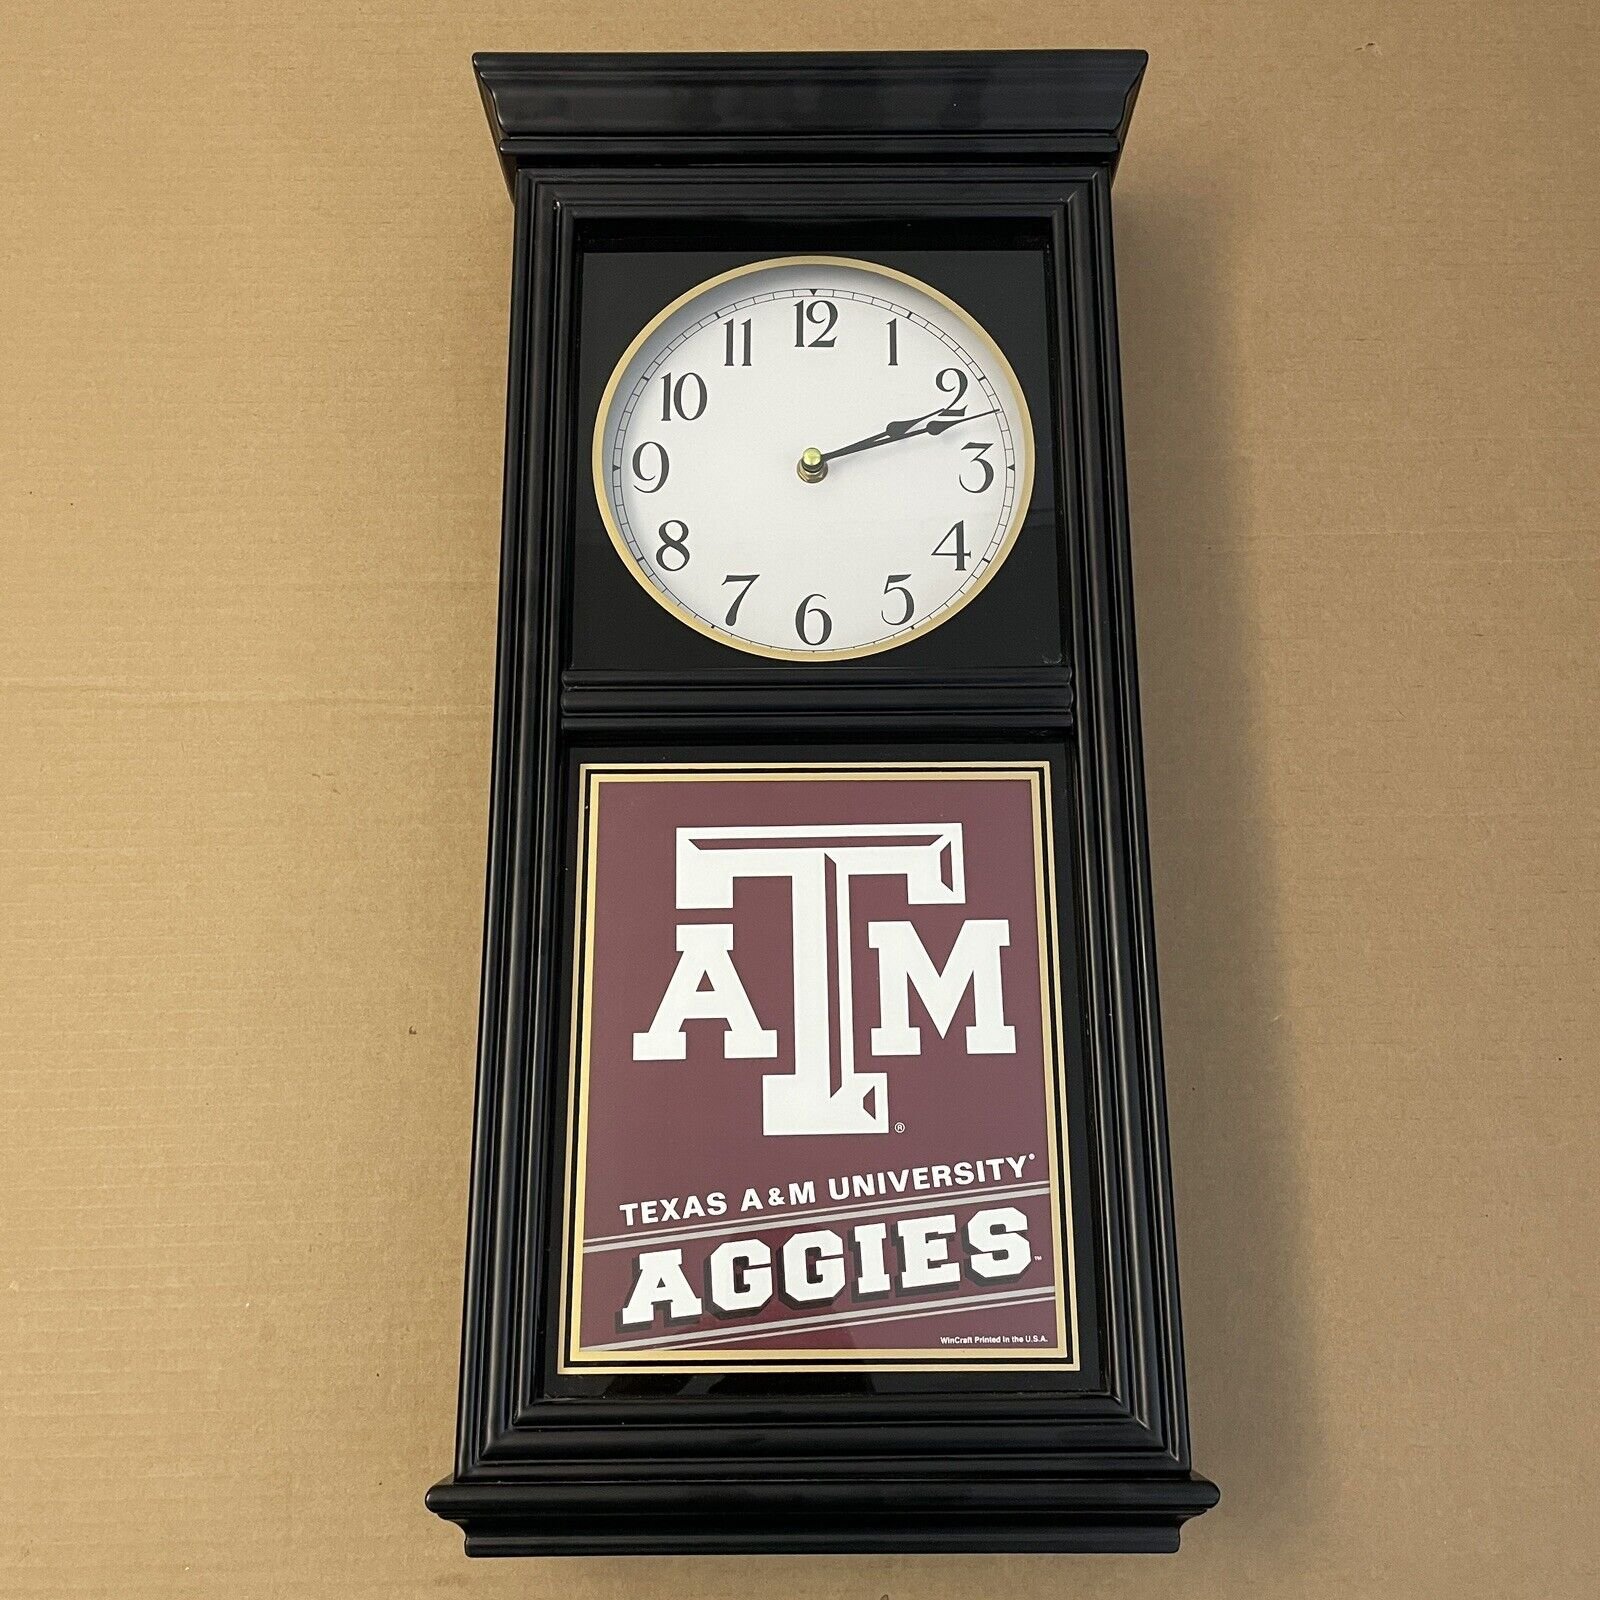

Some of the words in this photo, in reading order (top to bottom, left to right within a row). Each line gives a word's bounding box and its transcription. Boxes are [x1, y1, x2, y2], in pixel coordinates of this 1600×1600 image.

[723, 318, 752, 366] 11
[793, 300, 839, 347] 12
[886, 318, 899, 366] 1
[660, 372, 707, 421] 10
[935, 368, 968, 416] 2
[632, 441, 670, 493] 9
[958, 442, 994, 493] 3
[655, 519, 691, 571] 8
[931, 520, 972, 571] 4
[721, 574, 760, 626] 7
[795, 593, 832, 645] 6
[881, 574, 914, 625] 5
[619, 1192, 727, 1226] TEXAS
[741, 1181, 816, 1209] A&M
[828, 1156, 1029, 1200] UNIVERSITY
[622, 1207, 1031, 1324] AGGIES
